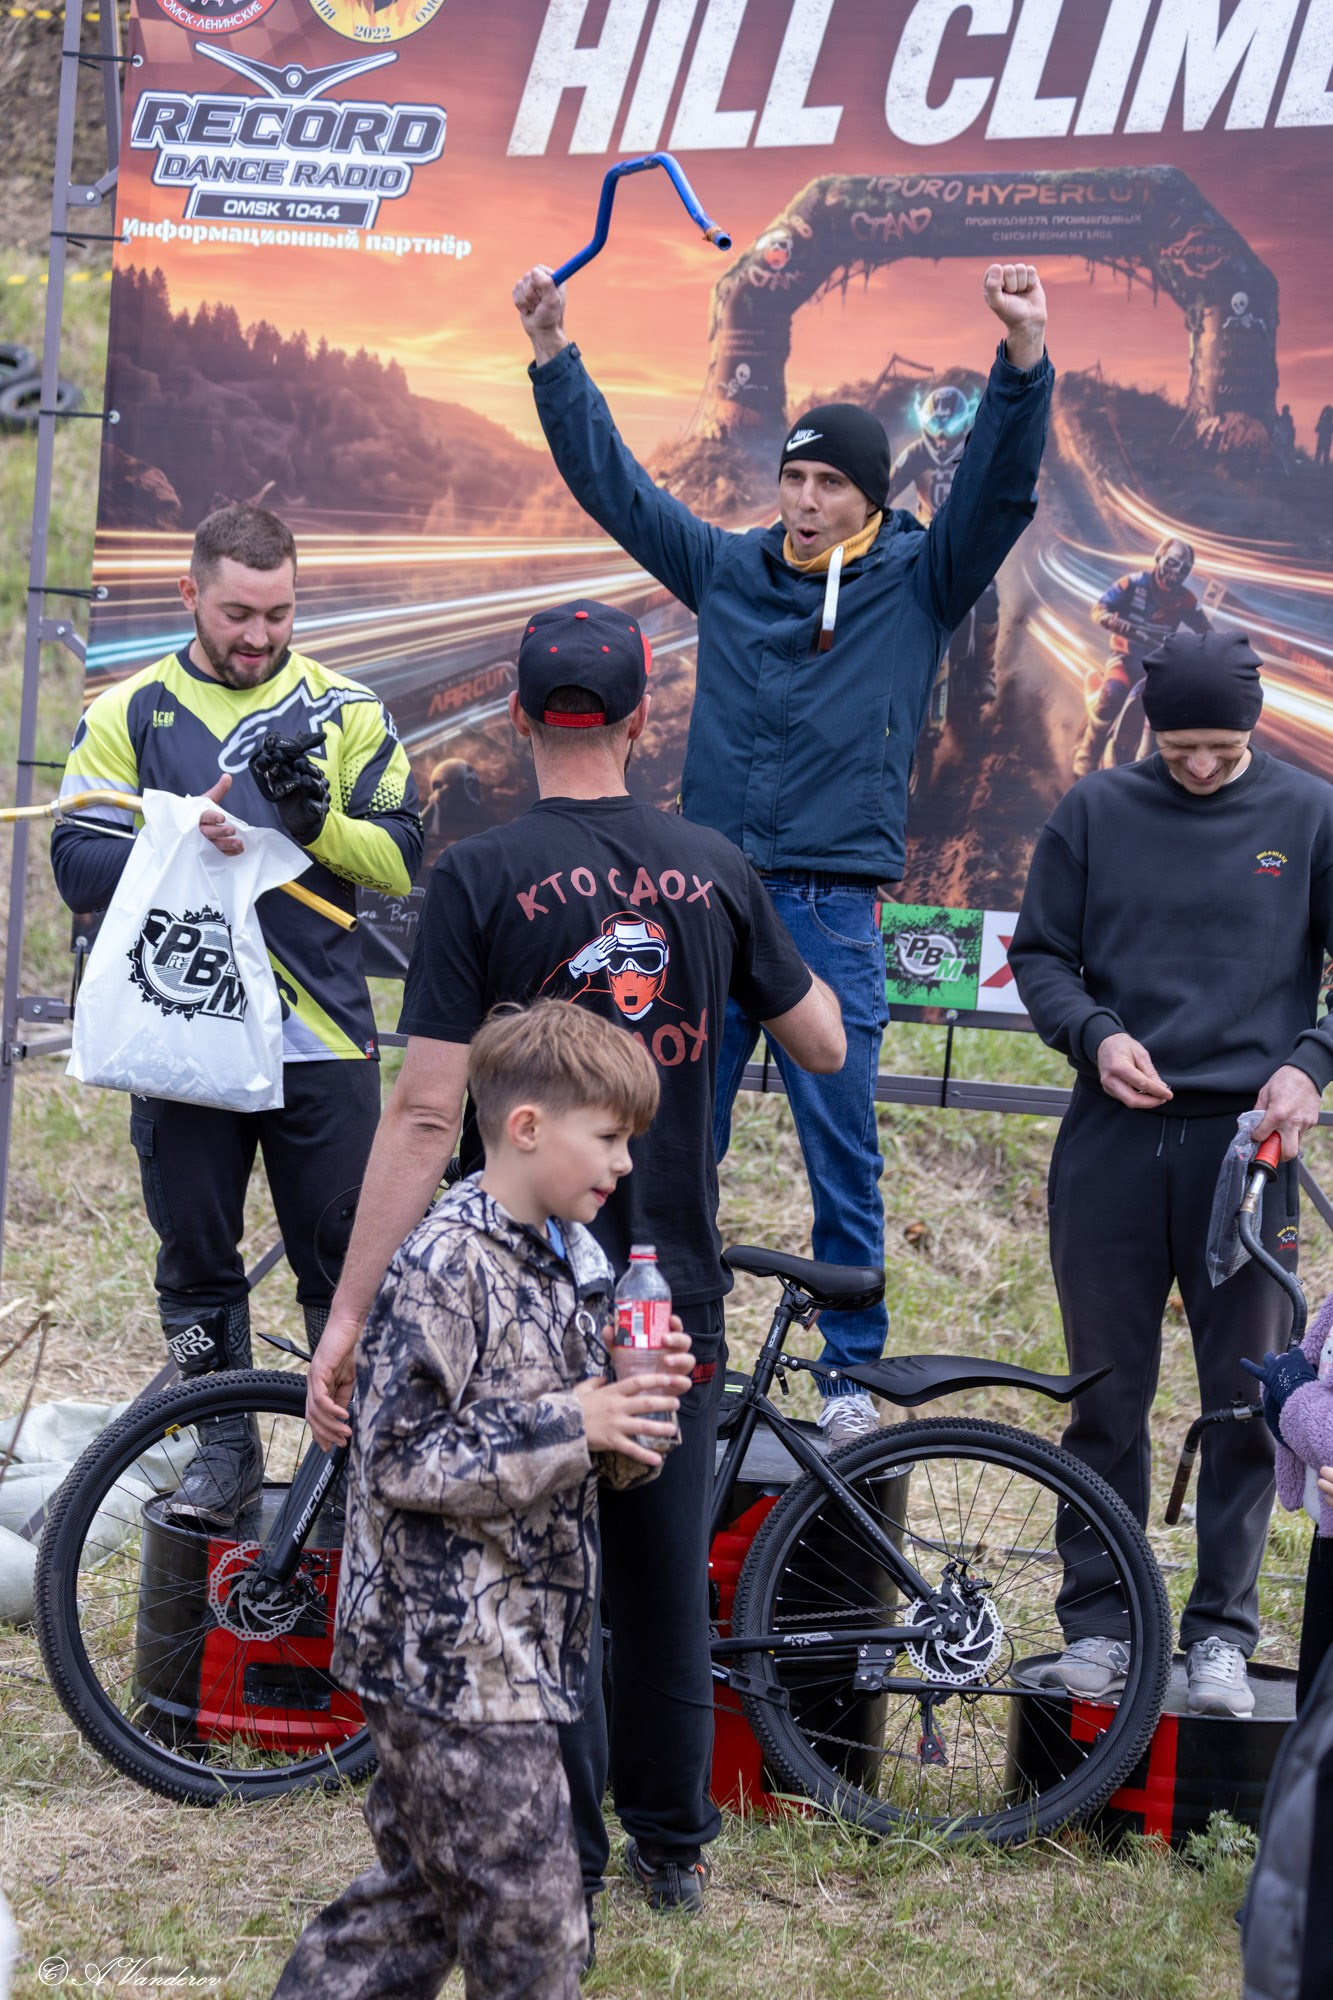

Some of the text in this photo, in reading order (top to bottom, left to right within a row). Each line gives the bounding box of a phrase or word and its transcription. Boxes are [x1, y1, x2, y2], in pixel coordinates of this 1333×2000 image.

[354, 25, 391, 39] 2022
[506, 0, 844, 156] HILL
[131, 95, 445, 157] RECORD
[160, 153, 406, 191] DANCE RADIO
[223, 199, 341, 220] OMSK 104.4
[122, 218, 472, 260] Информационный партнёр
[516, 866, 714, 921] КТО СДОХ
[632, 1007, 708, 1066] ОХ
[292, 1458, 336, 1544] MACOGE
